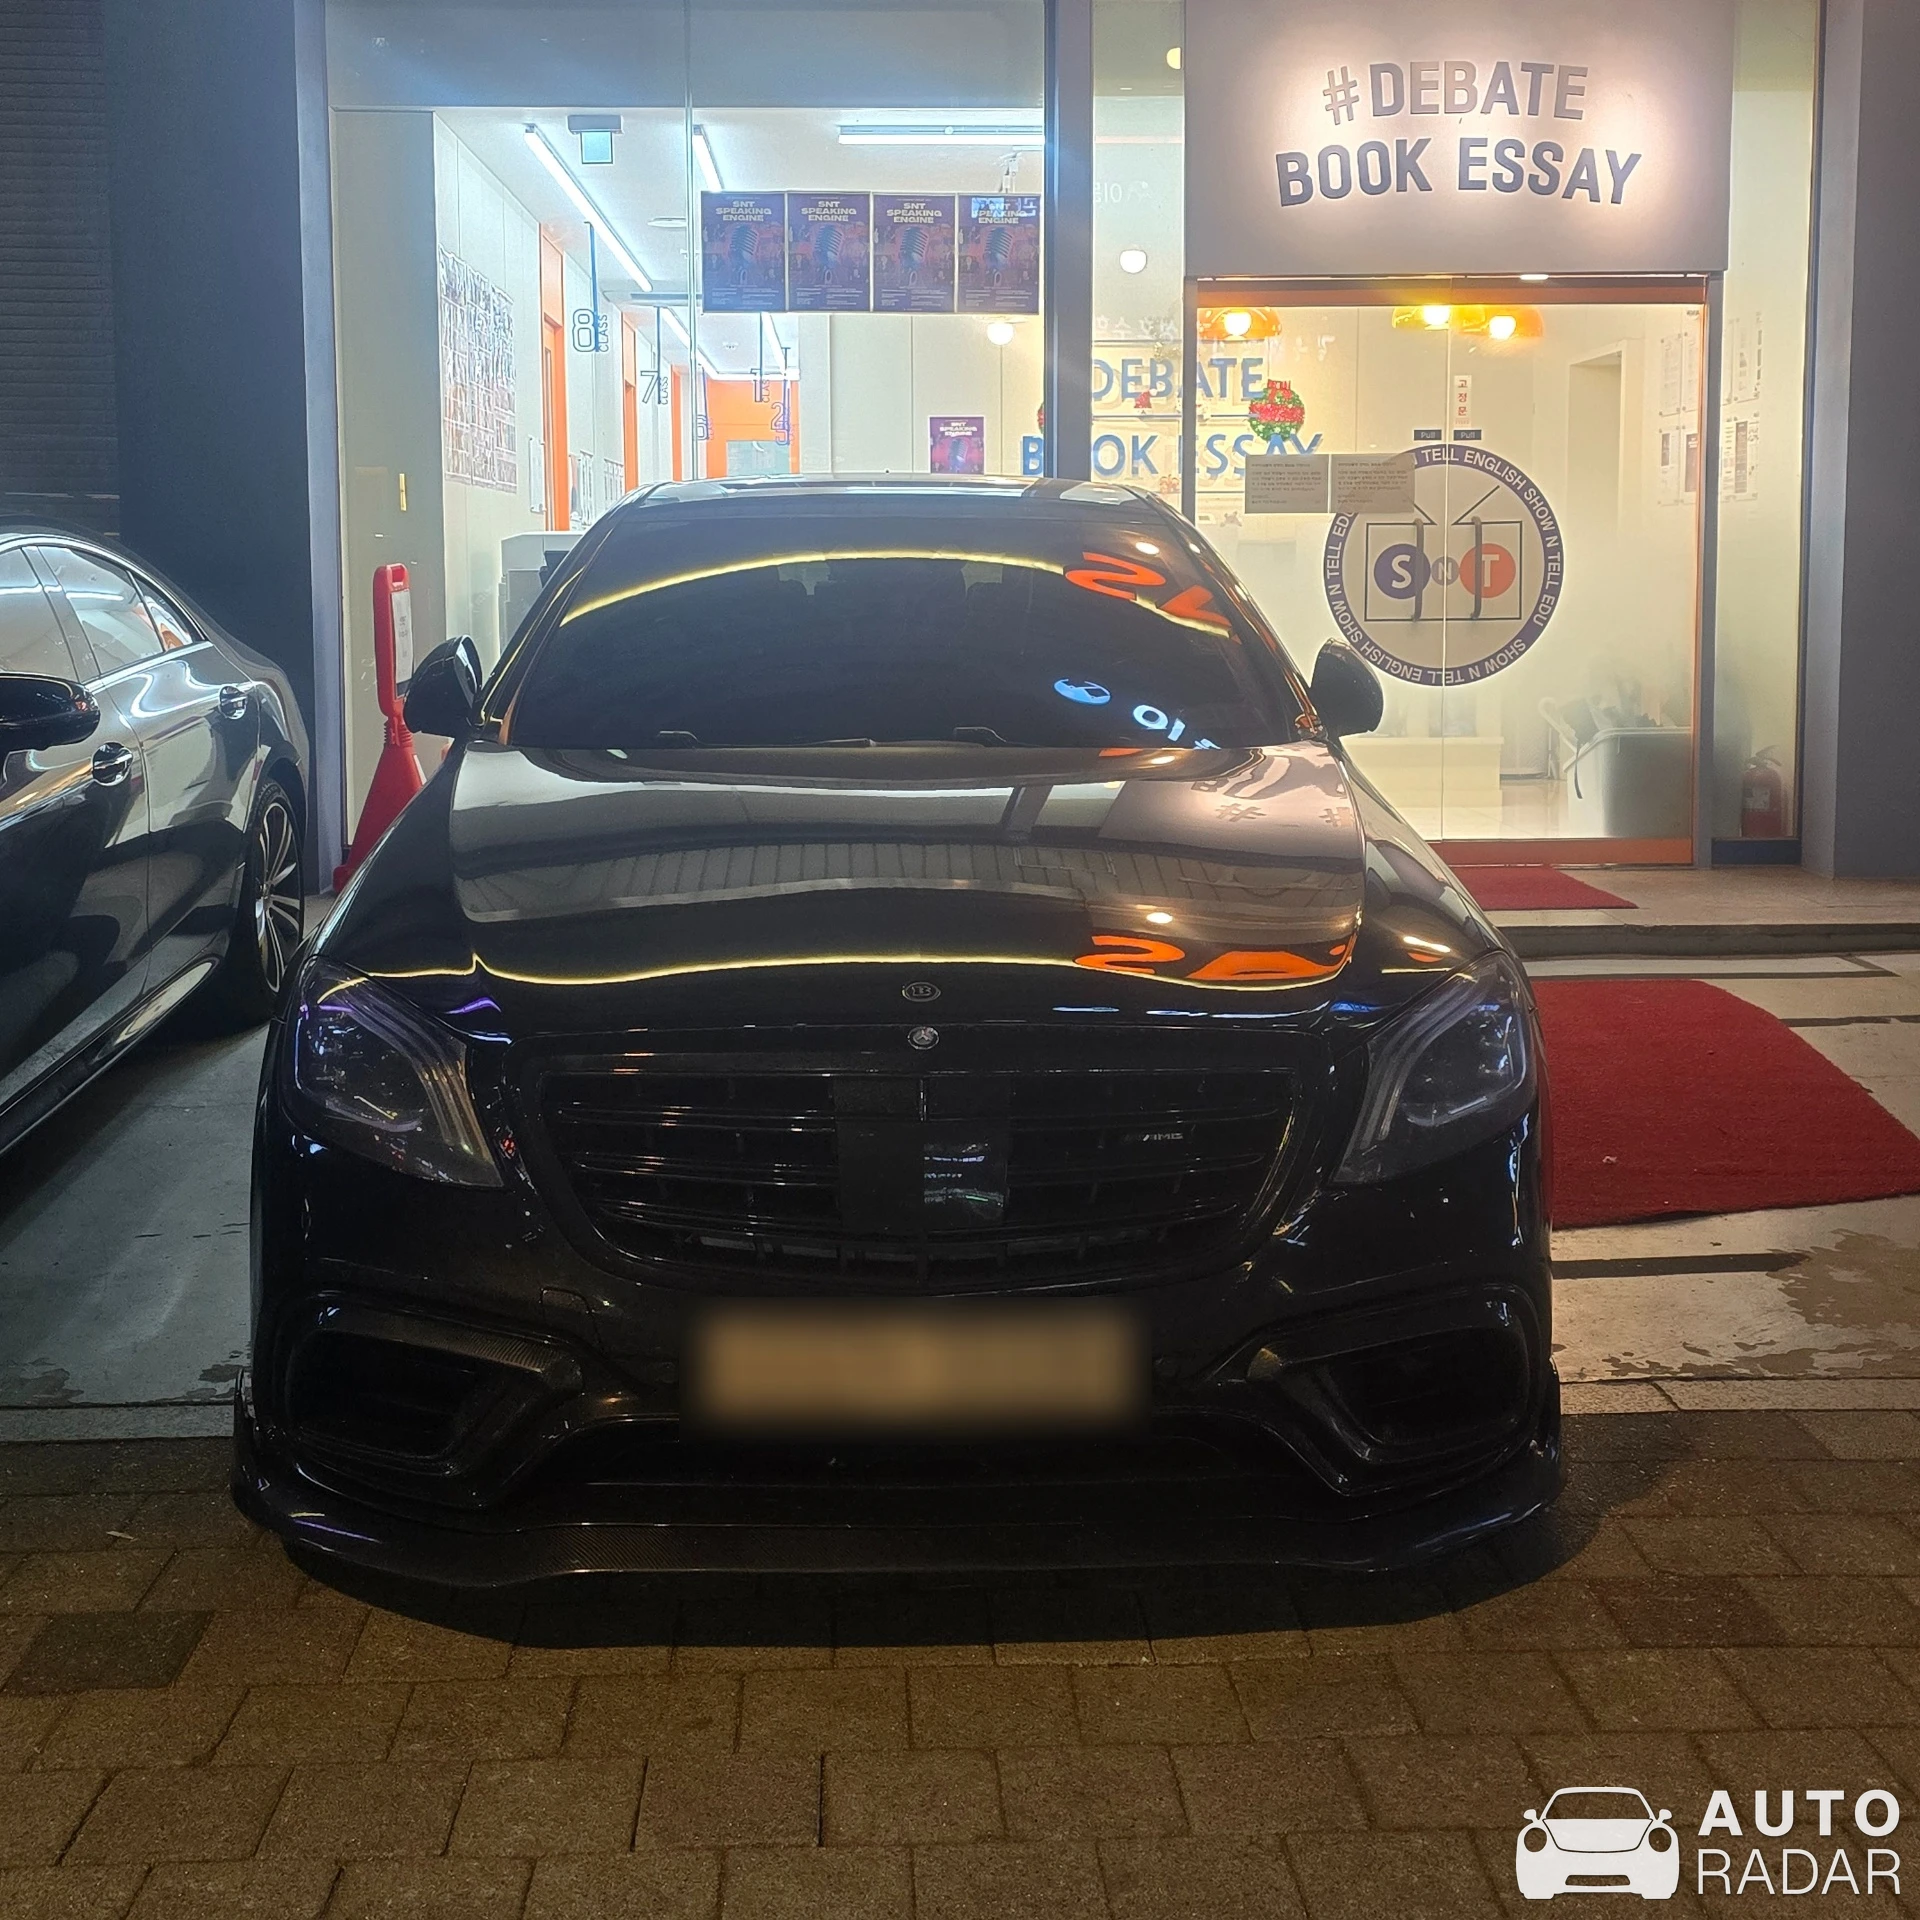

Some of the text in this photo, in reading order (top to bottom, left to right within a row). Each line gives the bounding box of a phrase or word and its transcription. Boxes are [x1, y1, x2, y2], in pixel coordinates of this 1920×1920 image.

[1276, 138, 1642, 207] BOOK ESSAY
[715, 207, 772, 215] SPEAKING
[722, 214, 764, 222] ENGINE
[801, 207, 857, 215] SPEAKING
[808, 214, 849, 222] ENGINE
[886, 209, 943, 217] SPEAKING
[893, 216, 934, 224] ENGINE
[978, 216, 1019, 224] ENGINE
[572, 309, 609, 353] 8 CLASS
[640, 371, 669, 405] 7 CLASS
[1457, 379, 1468, 416] 고정문
[1421, 431, 1436, 439] Pull
[1461, 431, 1476, 439] Pull
[1022, 434, 1158, 476] BOK
[1421, 448, 1459, 464] TELL
[1463, 450, 1527, 491] ENGLISH
[1523, 488, 1556, 532] SHOW
[1545, 535, 1559, 548] N
[1326, 541, 1343, 580] TELL
[1545, 552, 1561, 590] TELL
[1328, 583, 1342, 596] N
[1532, 594, 1556, 627] EDU
[1331, 599, 1364, 643] SHOW
[1361, 640, 1422, 682] ENGLISH
[1484, 638, 1527, 672] SHOW
[1427, 670, 1465, 684] TELL
[1469, 664, 1481, 679] N
